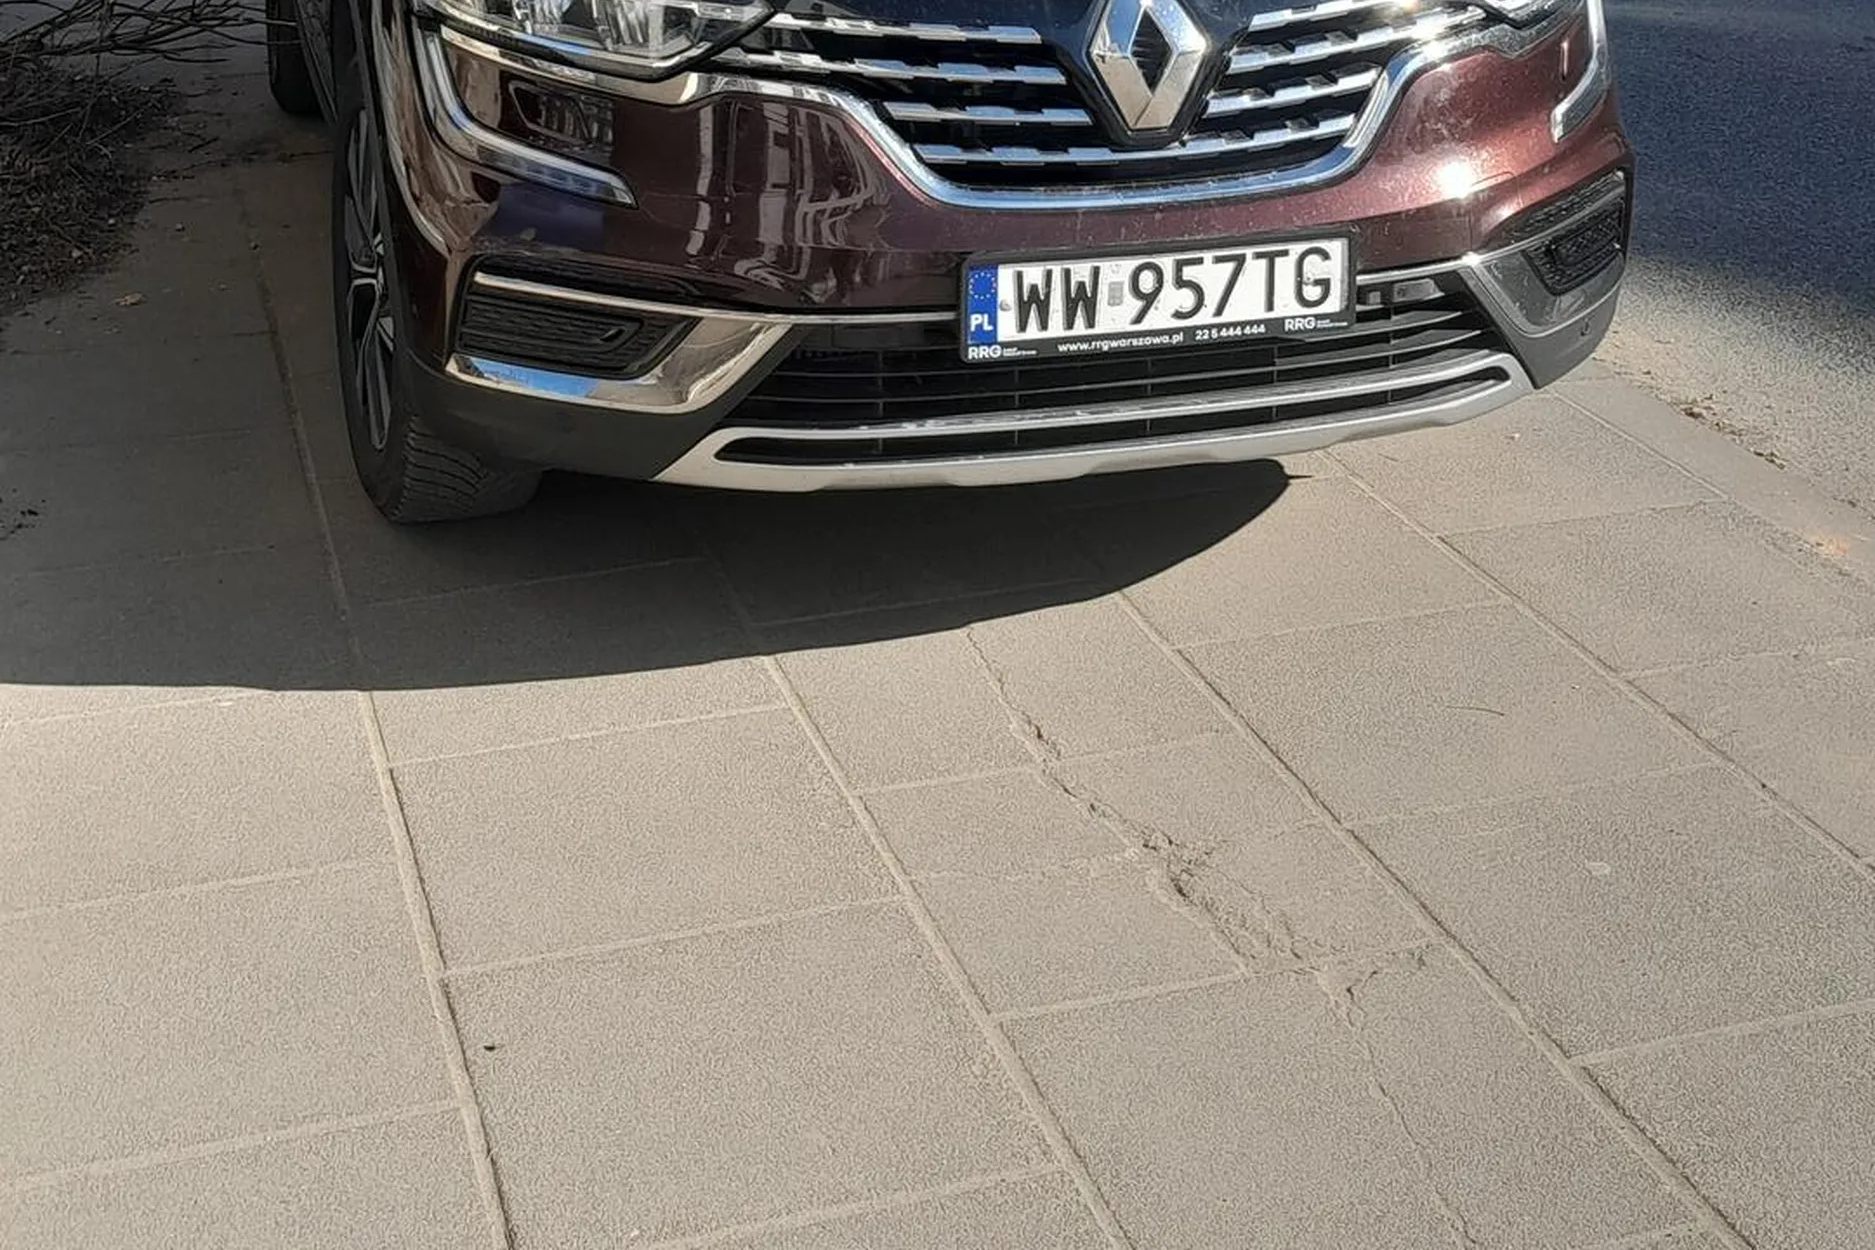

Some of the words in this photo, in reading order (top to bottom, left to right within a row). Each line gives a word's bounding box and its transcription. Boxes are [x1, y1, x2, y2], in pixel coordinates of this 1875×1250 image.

[1013, 265, 1102, 333] WW
[1128, 246, 1332, 325] 957TG
[970, 314, 994, 331] PL
[1284, 317, 1316, 332] RRG
[968, 345, 1002, 360] RRG
